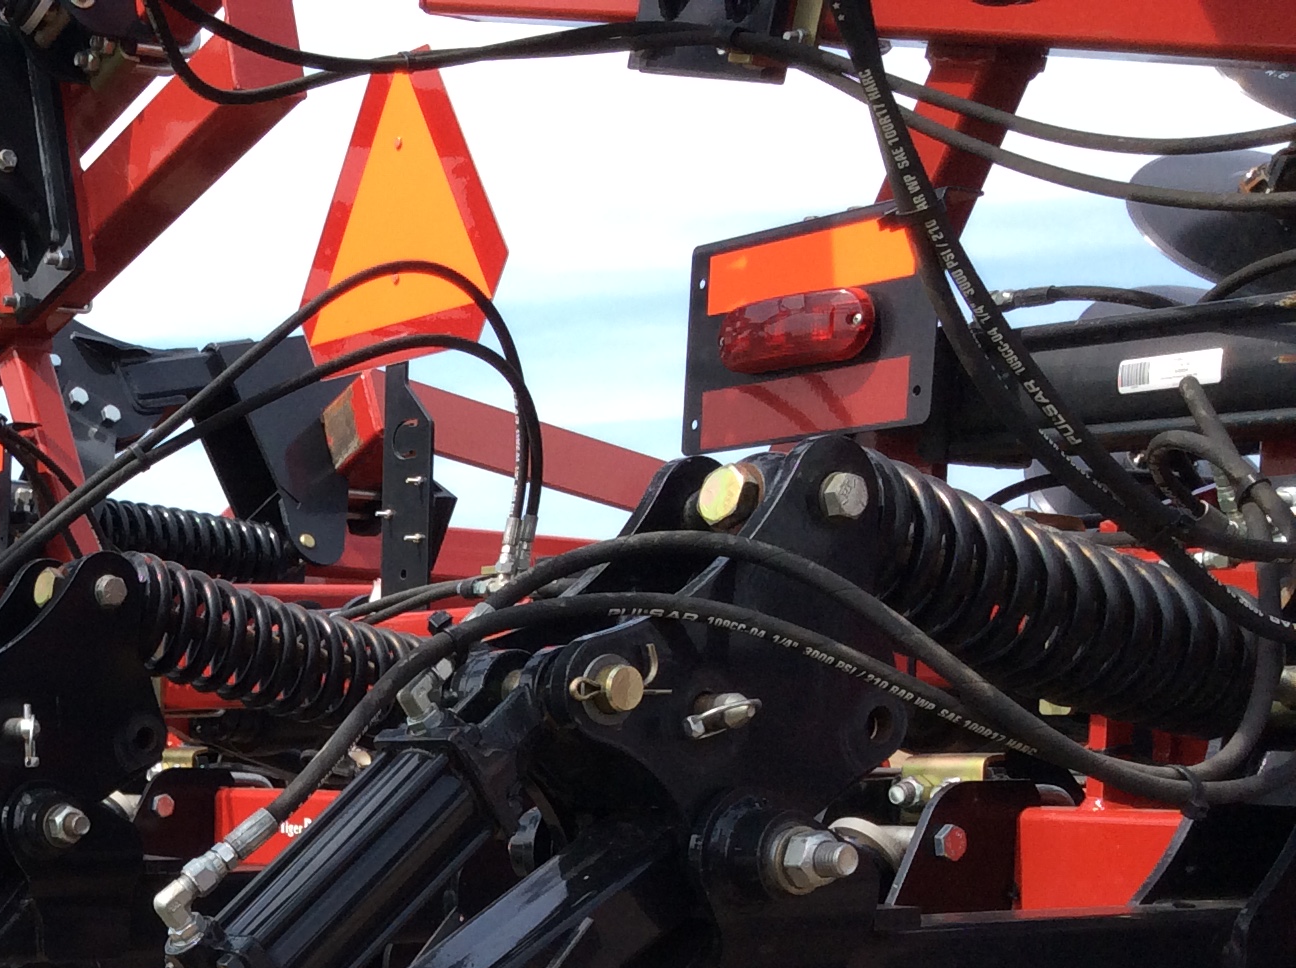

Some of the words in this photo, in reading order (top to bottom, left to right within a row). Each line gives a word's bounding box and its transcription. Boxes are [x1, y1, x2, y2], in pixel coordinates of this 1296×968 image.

[858, 68, 881, 100] HARC
[873, 103, 899, 145] 100R17
[891, 147, 910, 170] SAE
[903, 174, 920, 194] WP
[912, 194, 929, 211] AR
[925, 218, 944, 241] 210
[940, 249, 958, 269] PSI
[951, 268, 975, 297] 3000
[987, 326, 1026, 376] 109CC-04
[1023, 379, 1082, 445] PULSAR
[802, 646, 835, 666] 3000
[836, 660, 858, 676] PSI
[864, 673, 888, 691] 210
[889, 683, 915, 702] BAR
[915, 696, 936, 712] WP
[937, 707, 962, 724] SAE
[962, 719, 1007, 744] 100R17
